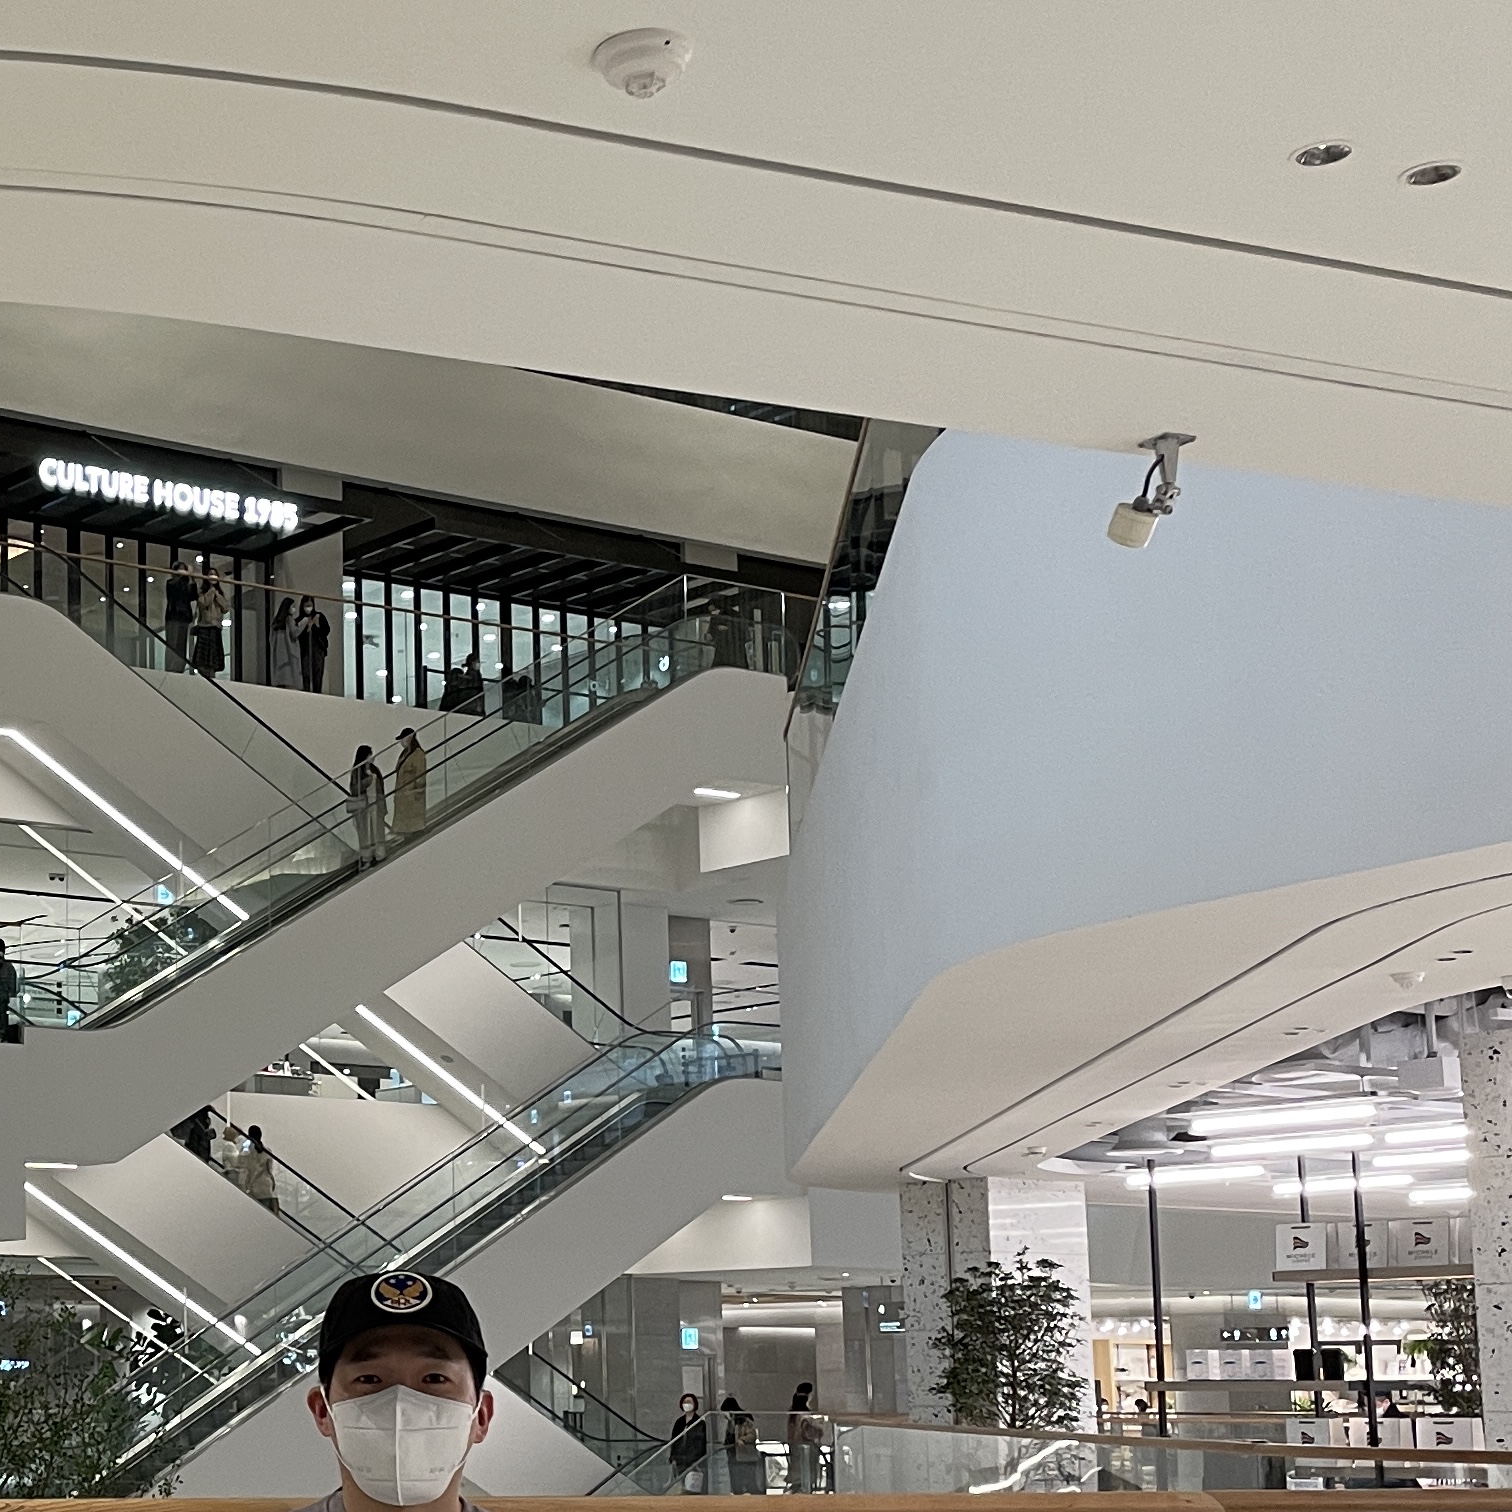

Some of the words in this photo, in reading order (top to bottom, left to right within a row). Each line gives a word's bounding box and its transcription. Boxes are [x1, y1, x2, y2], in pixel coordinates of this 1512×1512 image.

[38, 457, 150, 506] CULTURE
[153, 478, 240, 524] HOUSE
[244, 496, 299, 532] 1985
